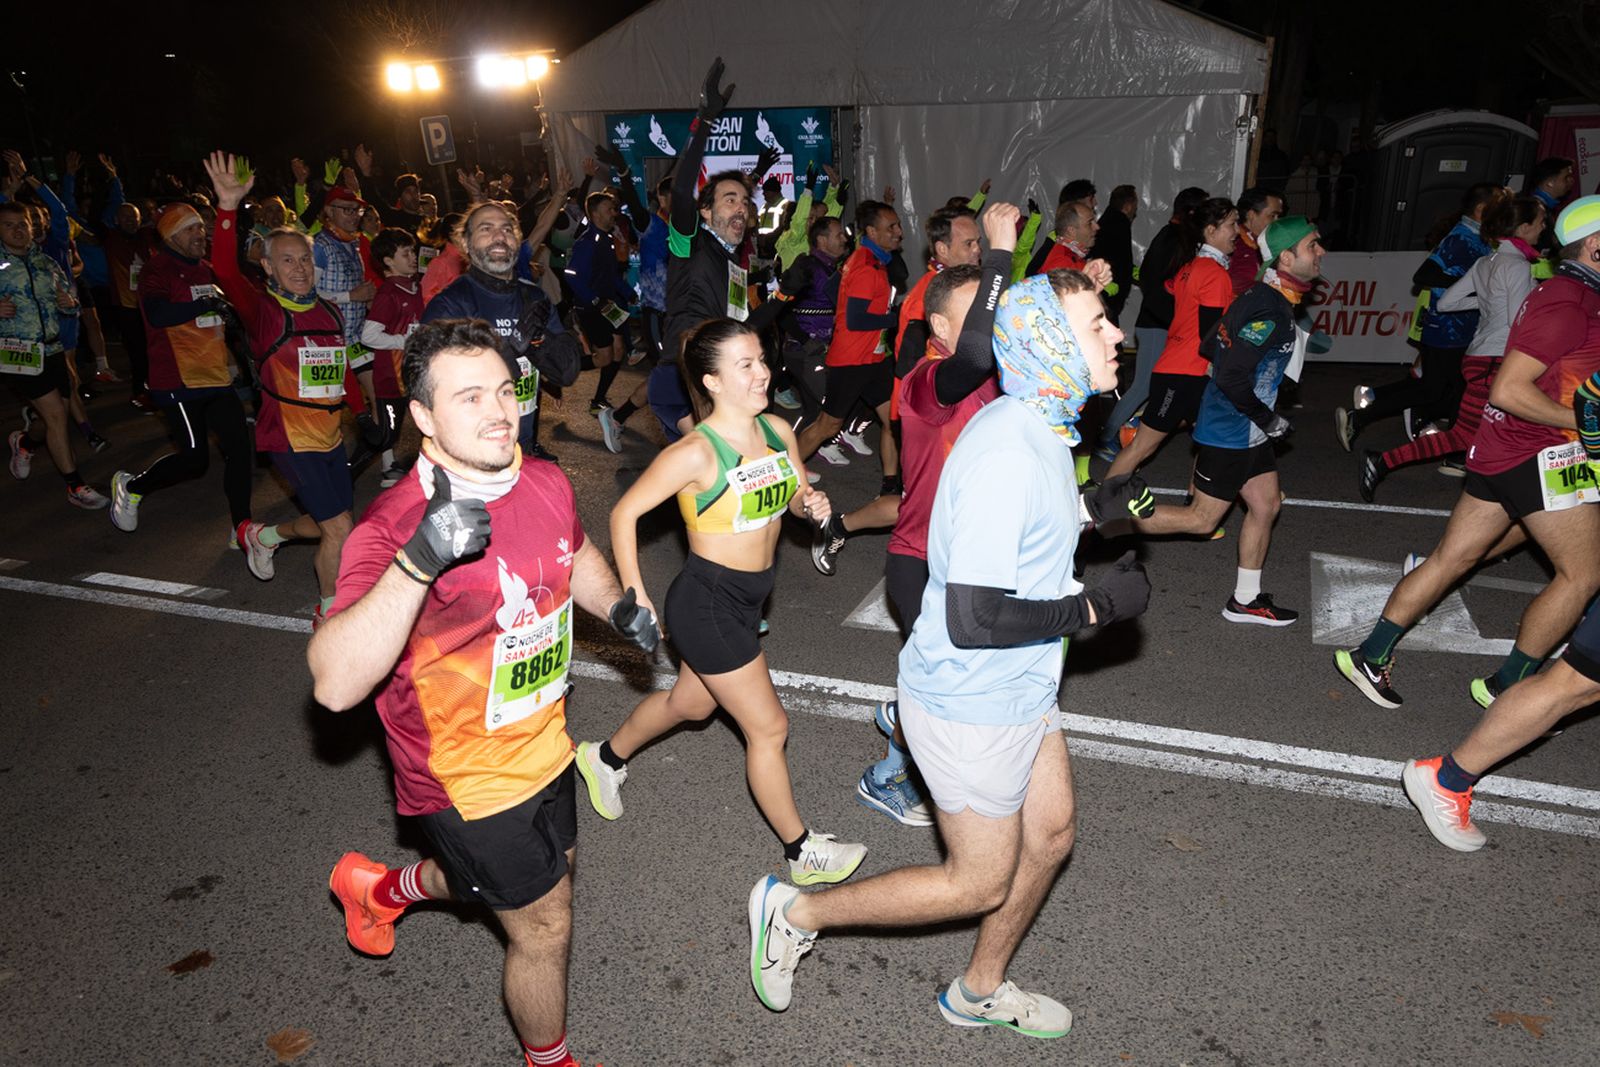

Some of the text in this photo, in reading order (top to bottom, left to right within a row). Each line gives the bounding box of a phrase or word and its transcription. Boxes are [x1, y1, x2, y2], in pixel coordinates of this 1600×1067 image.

[710, 117, 743, 133] SAN
[705, 133, 742, 152] TÓN
[985, 274, 1003, 311] KIPRUN
[1310, 279, 1378, 306] SAN
[495, 318, 512, 328] NO
[8, 350, 33, 363] 7716
[311, 365, 340, 381] 9221
[514, 374, 535, 397] 592
[1558, 463, 1591, 487] 104
[754, 481, 788, 513] 7477
[504, 648, 526, 663] SAN
[510, 640, 564, 691] 8862
